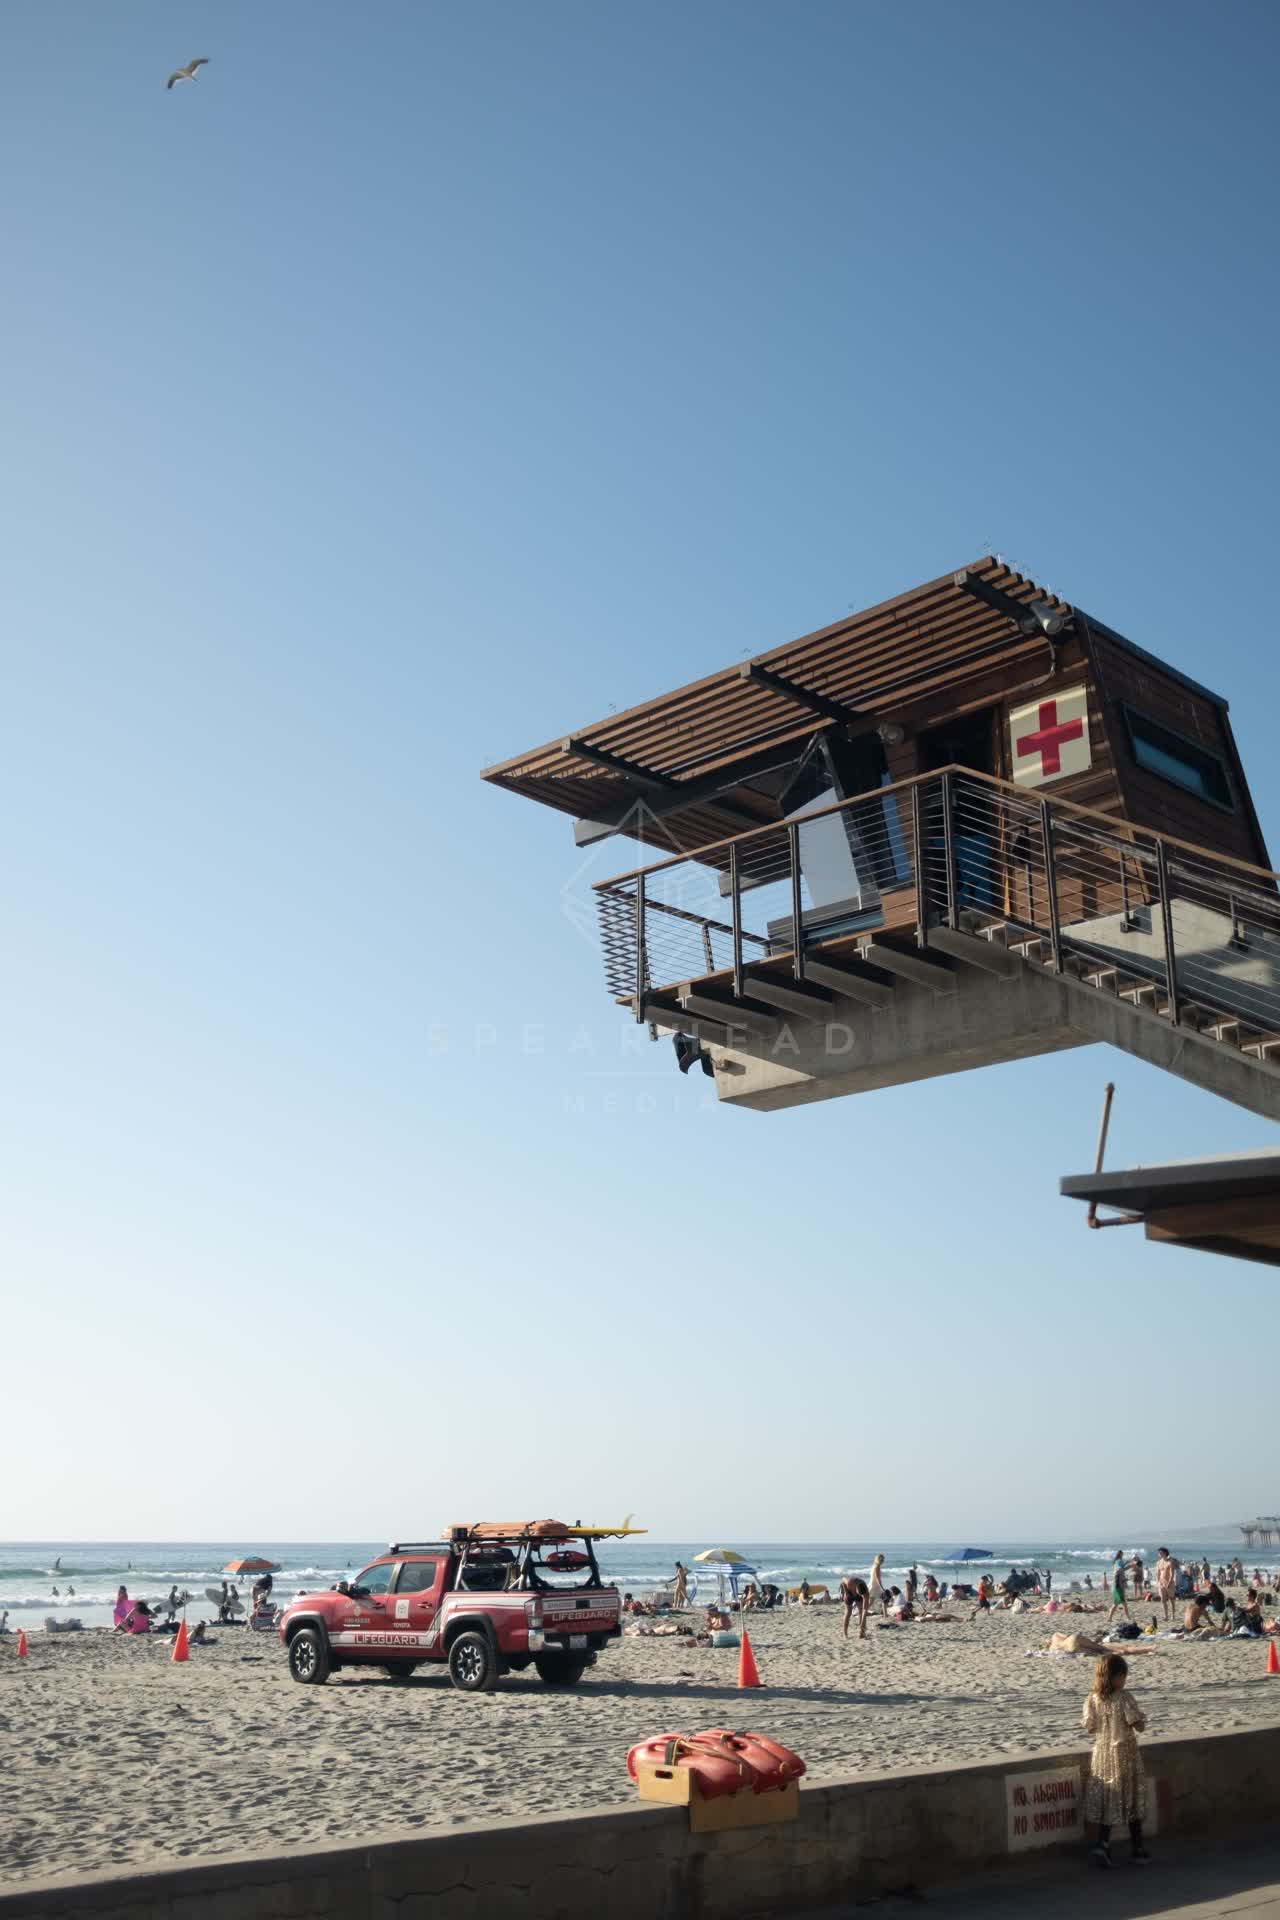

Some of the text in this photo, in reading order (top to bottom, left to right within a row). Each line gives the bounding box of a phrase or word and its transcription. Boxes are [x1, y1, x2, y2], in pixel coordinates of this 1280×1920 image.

[552, 1610, 611, 1621] LIFEGUARD
[356, 1634, 417, 1645] LIFEGUARD
[1014, 1785, 1027, 1807] NO
[1014, 1815, 1028, 1836] NO
